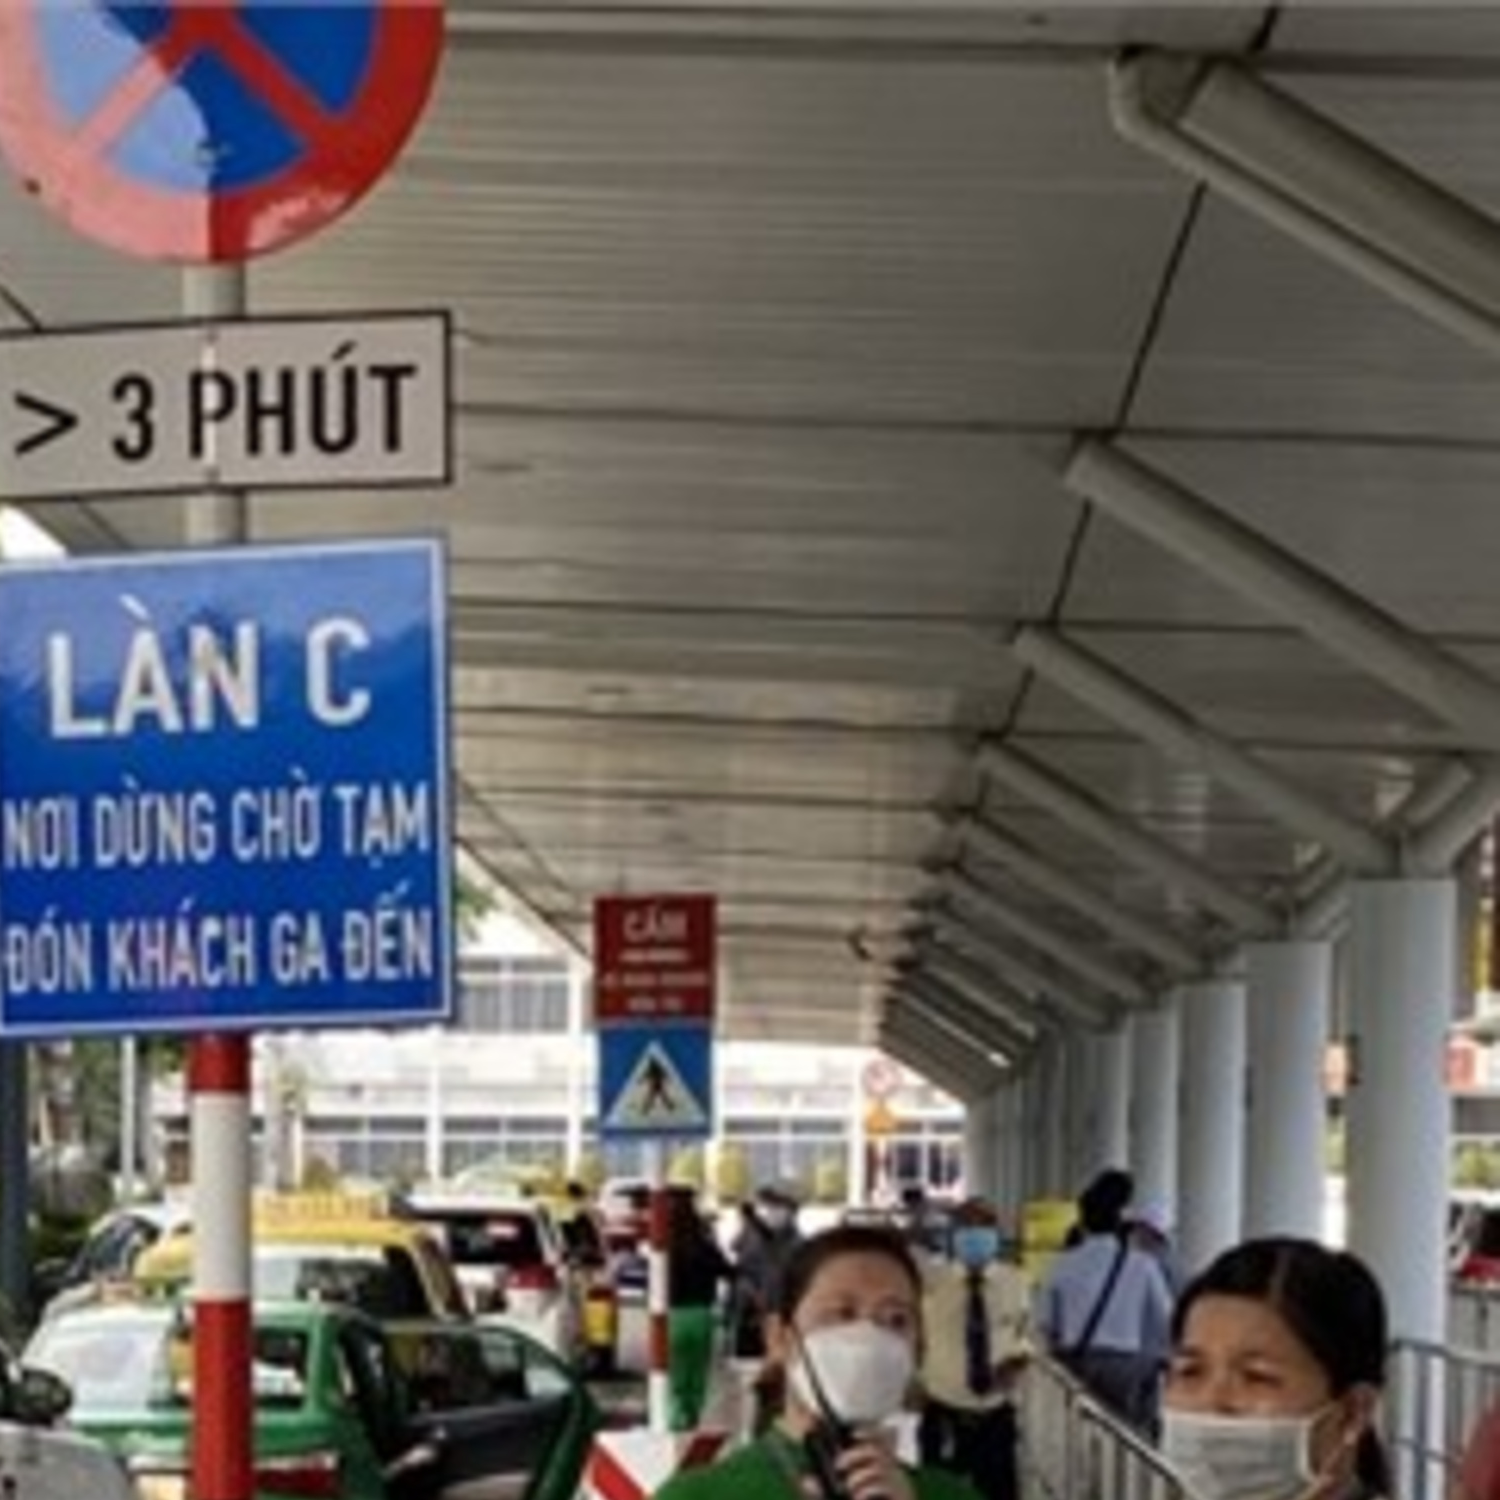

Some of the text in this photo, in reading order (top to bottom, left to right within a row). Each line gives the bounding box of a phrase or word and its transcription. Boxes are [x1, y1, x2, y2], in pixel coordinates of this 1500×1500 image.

[111, 373, 154, 461] 3
[189, 341, 417, 459] PHÚT
[50, 593, 371, 738] LÀN C
[3, 766, 430, 869] NƠI DỪNG CHỜ TẠM
[5, 881, 434, 994] ĐÓN KHÁCH GA ĐẾN
